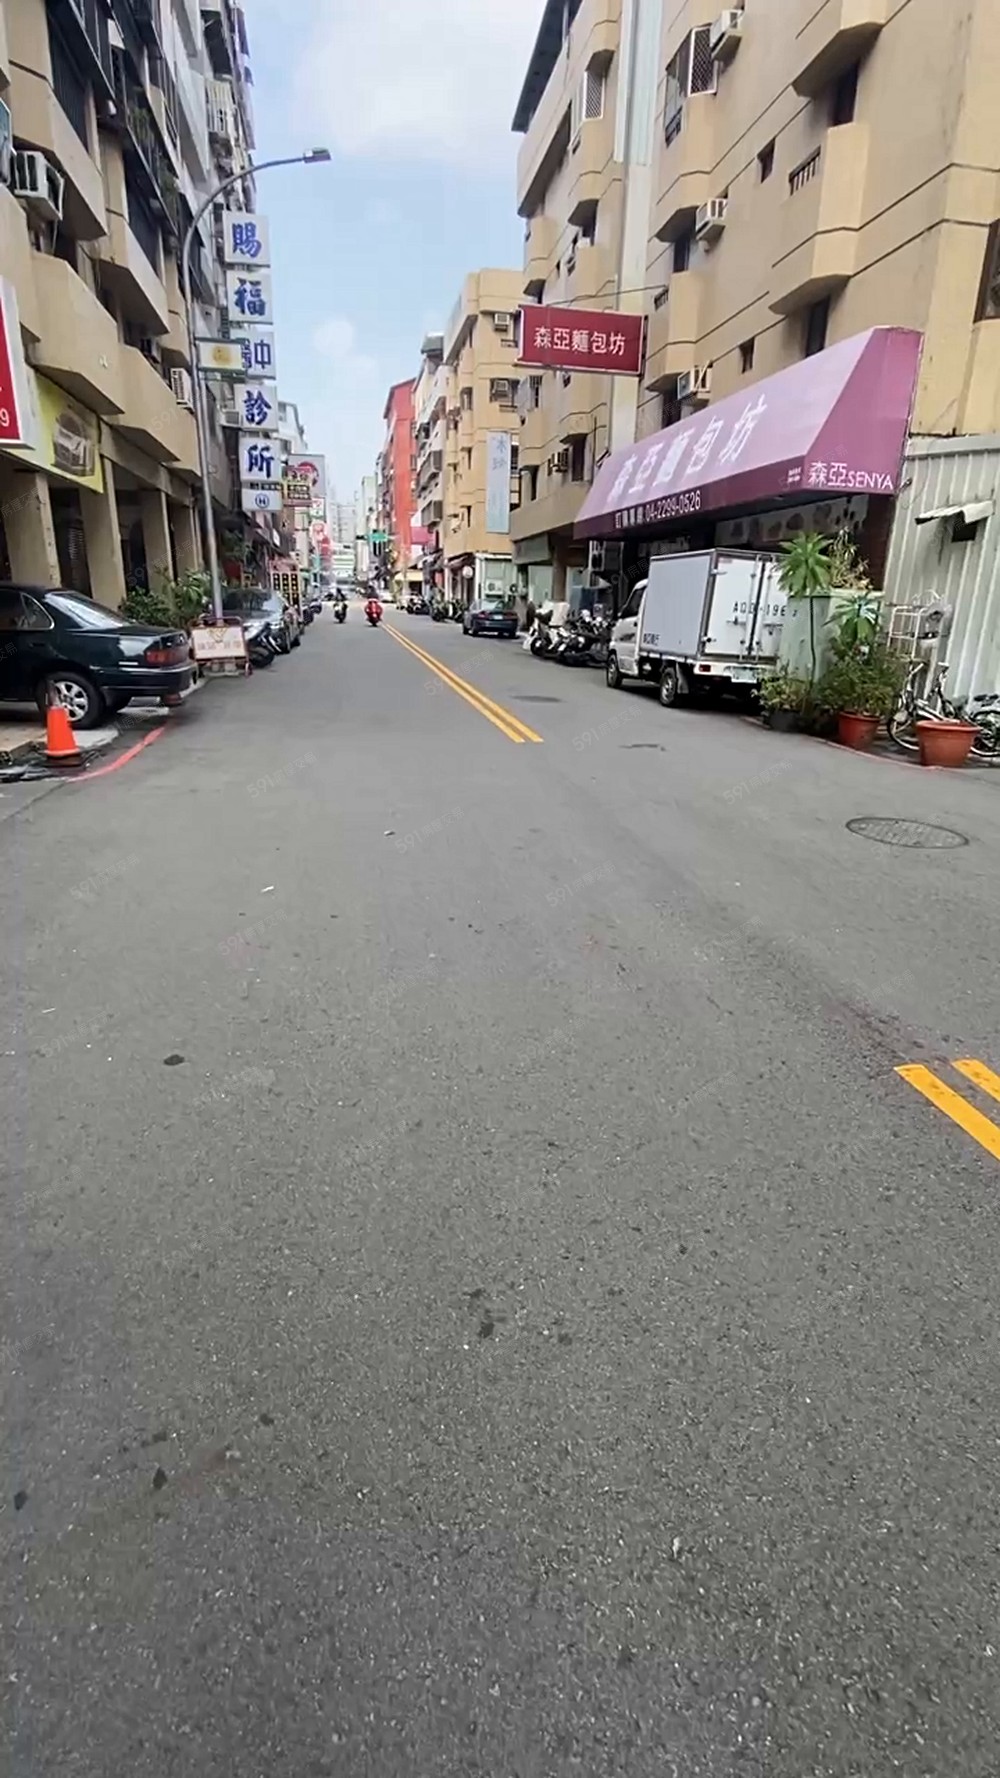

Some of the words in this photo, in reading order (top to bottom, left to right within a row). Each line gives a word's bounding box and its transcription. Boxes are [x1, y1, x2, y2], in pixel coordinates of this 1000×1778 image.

[533, 326, 626, 356] 森亞麵包坊
[607, 394, 767, 503] 森亞麵包坊
